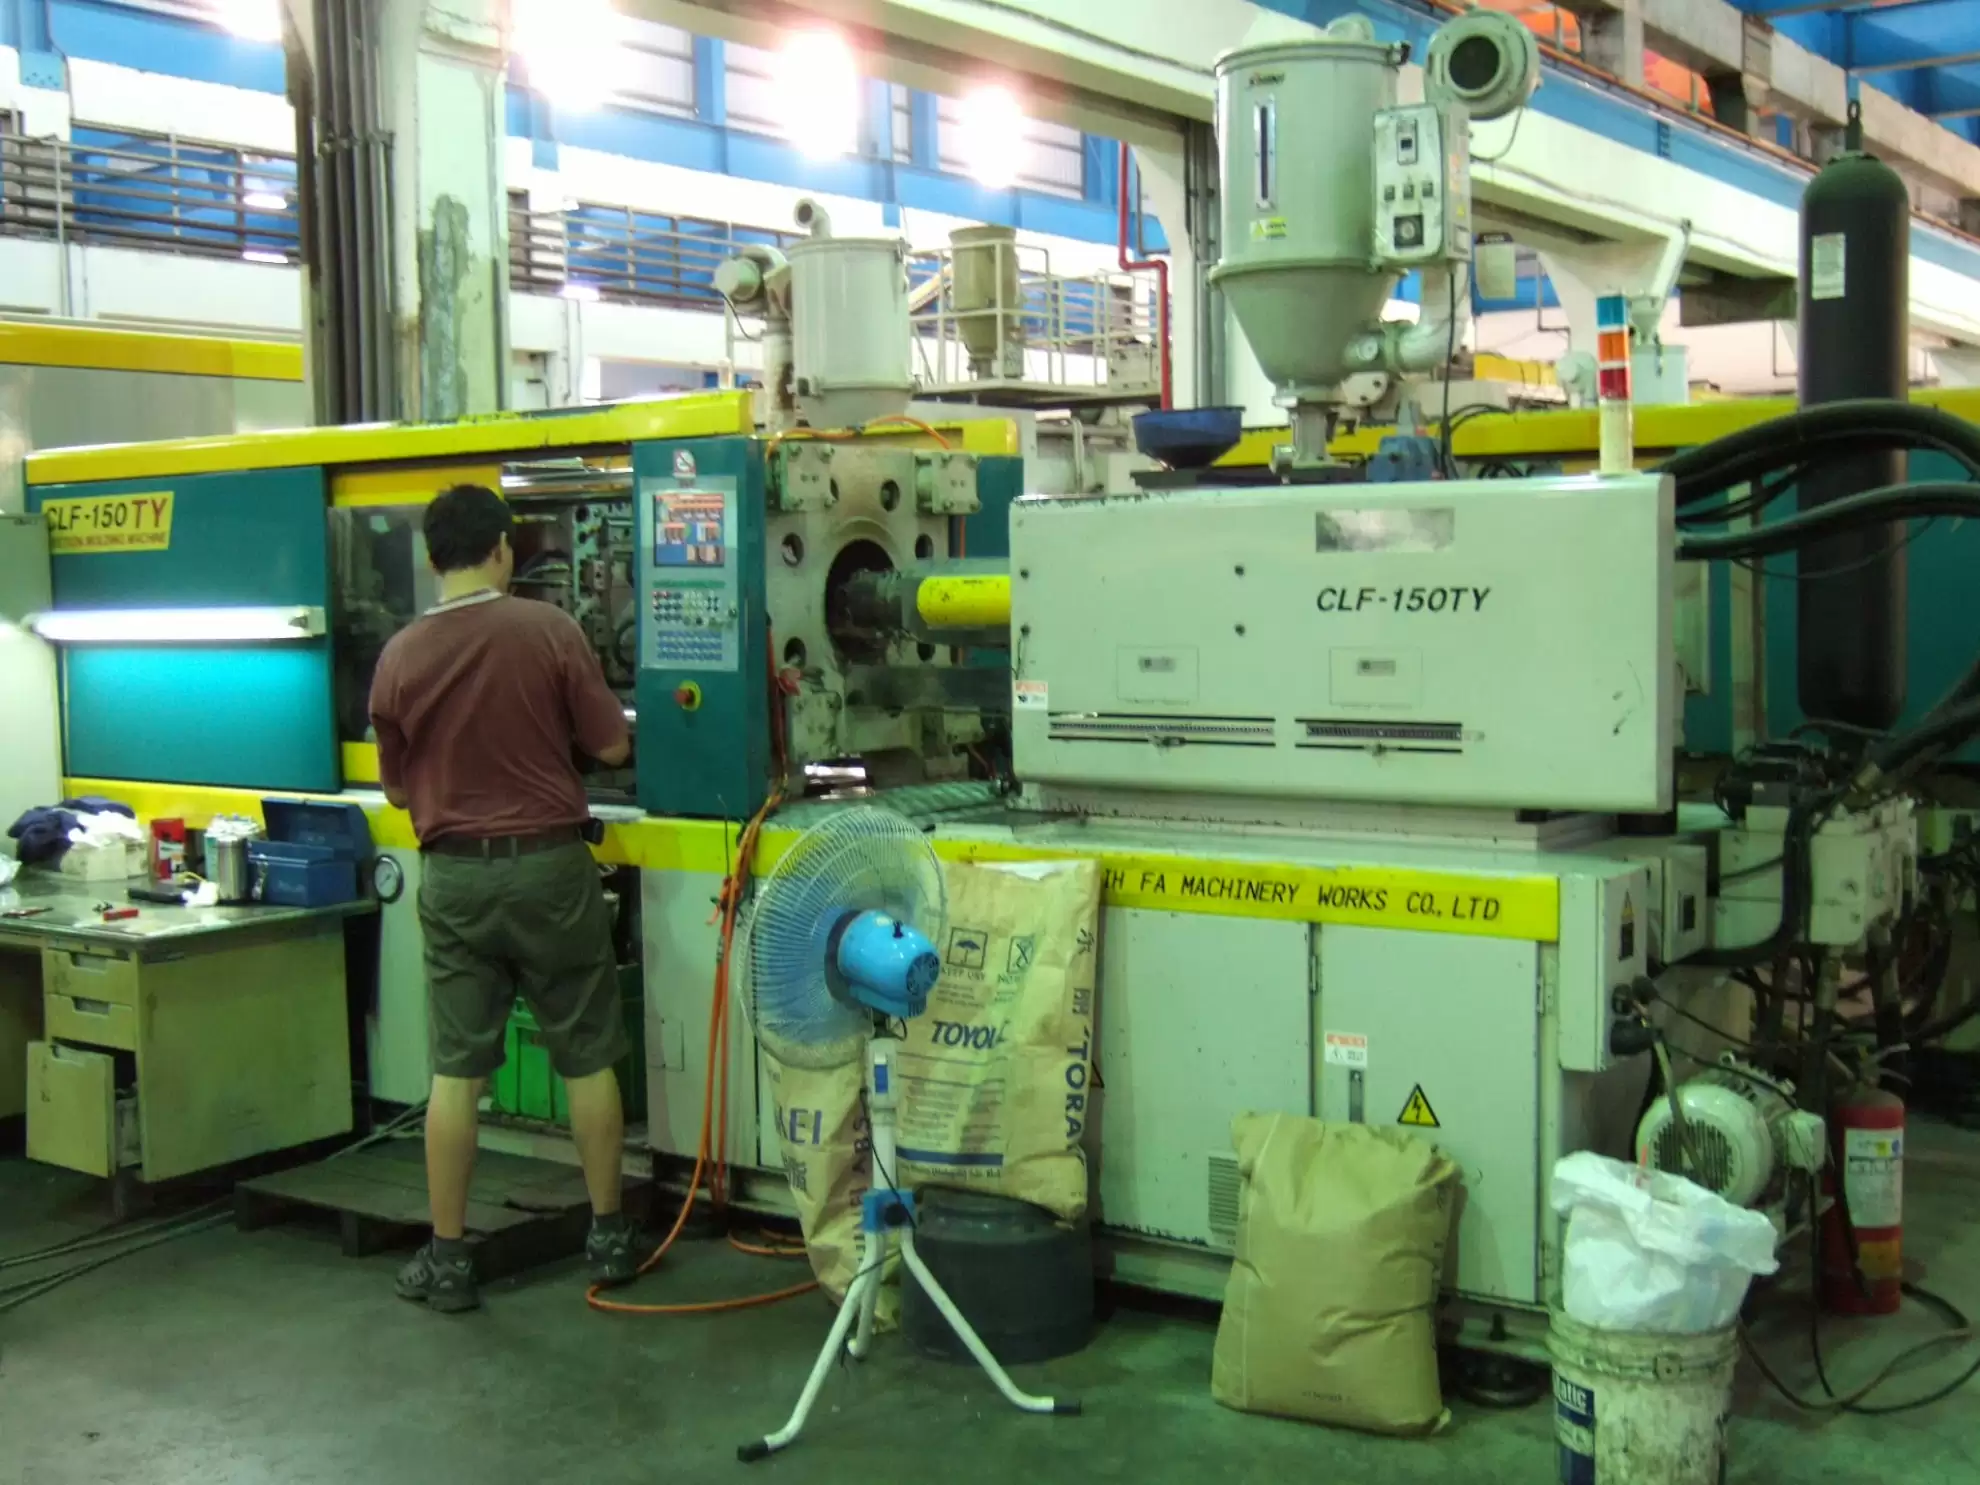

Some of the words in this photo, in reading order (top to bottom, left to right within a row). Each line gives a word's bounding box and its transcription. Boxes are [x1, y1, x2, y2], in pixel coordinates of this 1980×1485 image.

[1316, 586, 1491, 613] CLF-150TY
[1140, 871, 1167, 895] FA
[1179, 874, 1300, 905] MACHINERY
[1318, 884, 1388, 912] WORKS
[1451, 895, 1500, 921] LTD
